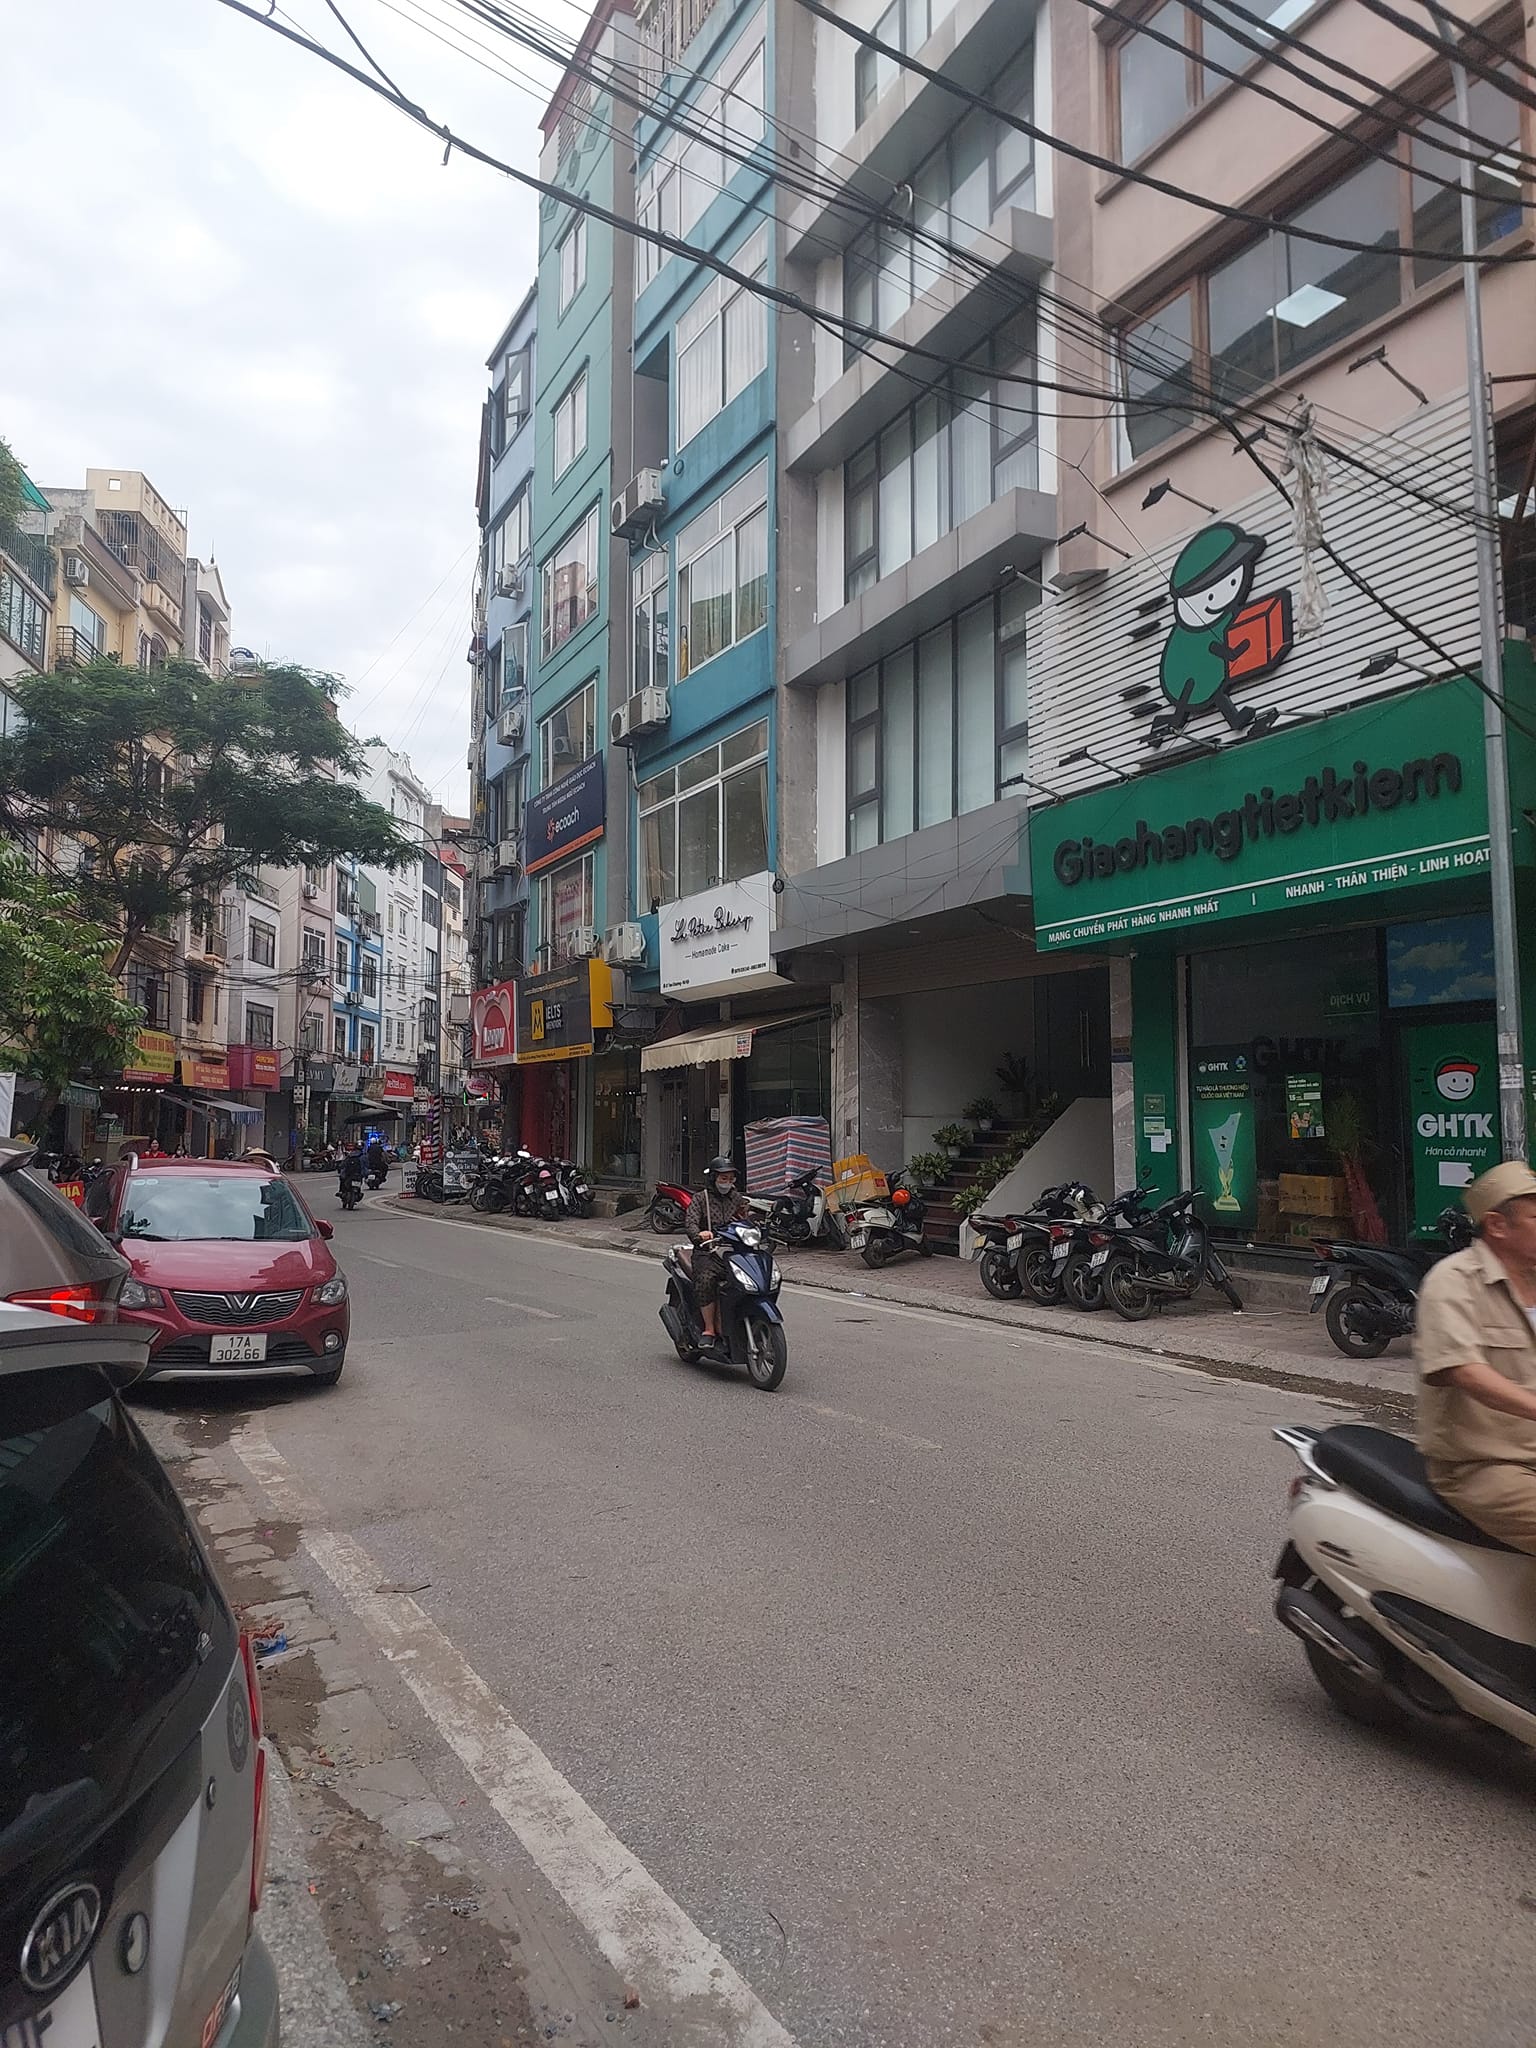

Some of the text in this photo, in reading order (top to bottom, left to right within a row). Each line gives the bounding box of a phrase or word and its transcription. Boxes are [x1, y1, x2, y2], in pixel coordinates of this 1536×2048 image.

[555, 805, 580, 833] ecoach
[1053, 752, 1462, 886] Giaohangtietkiem
[1286, 880, 1325, 898] NHANH
[1335, 871, 1367, 889] THÂN
[1371, 863, 1408, 882] THIỆN
[1419, 855, 1450, 874] LINH
[1454, 847, 1491, 866] HOẠT
[1048, 898, 1219, 944] MẠNG CHUYỂN PHÁT HÀNG NHANH NHẤT
[1330, 992, 1371, 1008] DỊCH VỤ
[545, 1003, 561, 1020] IELTS
[1207, 1062, 1229, 1071] GHTK
[1417, 1113, 1493, 1138] GHTK
[1425, 1146, 1487, 1157] Hơn cả nhanh!
[230, 1336, 251, 1348] 17A
[216, 1348, 260, 1361] 302.66
[38, 1897, 92, 1978] KIA
